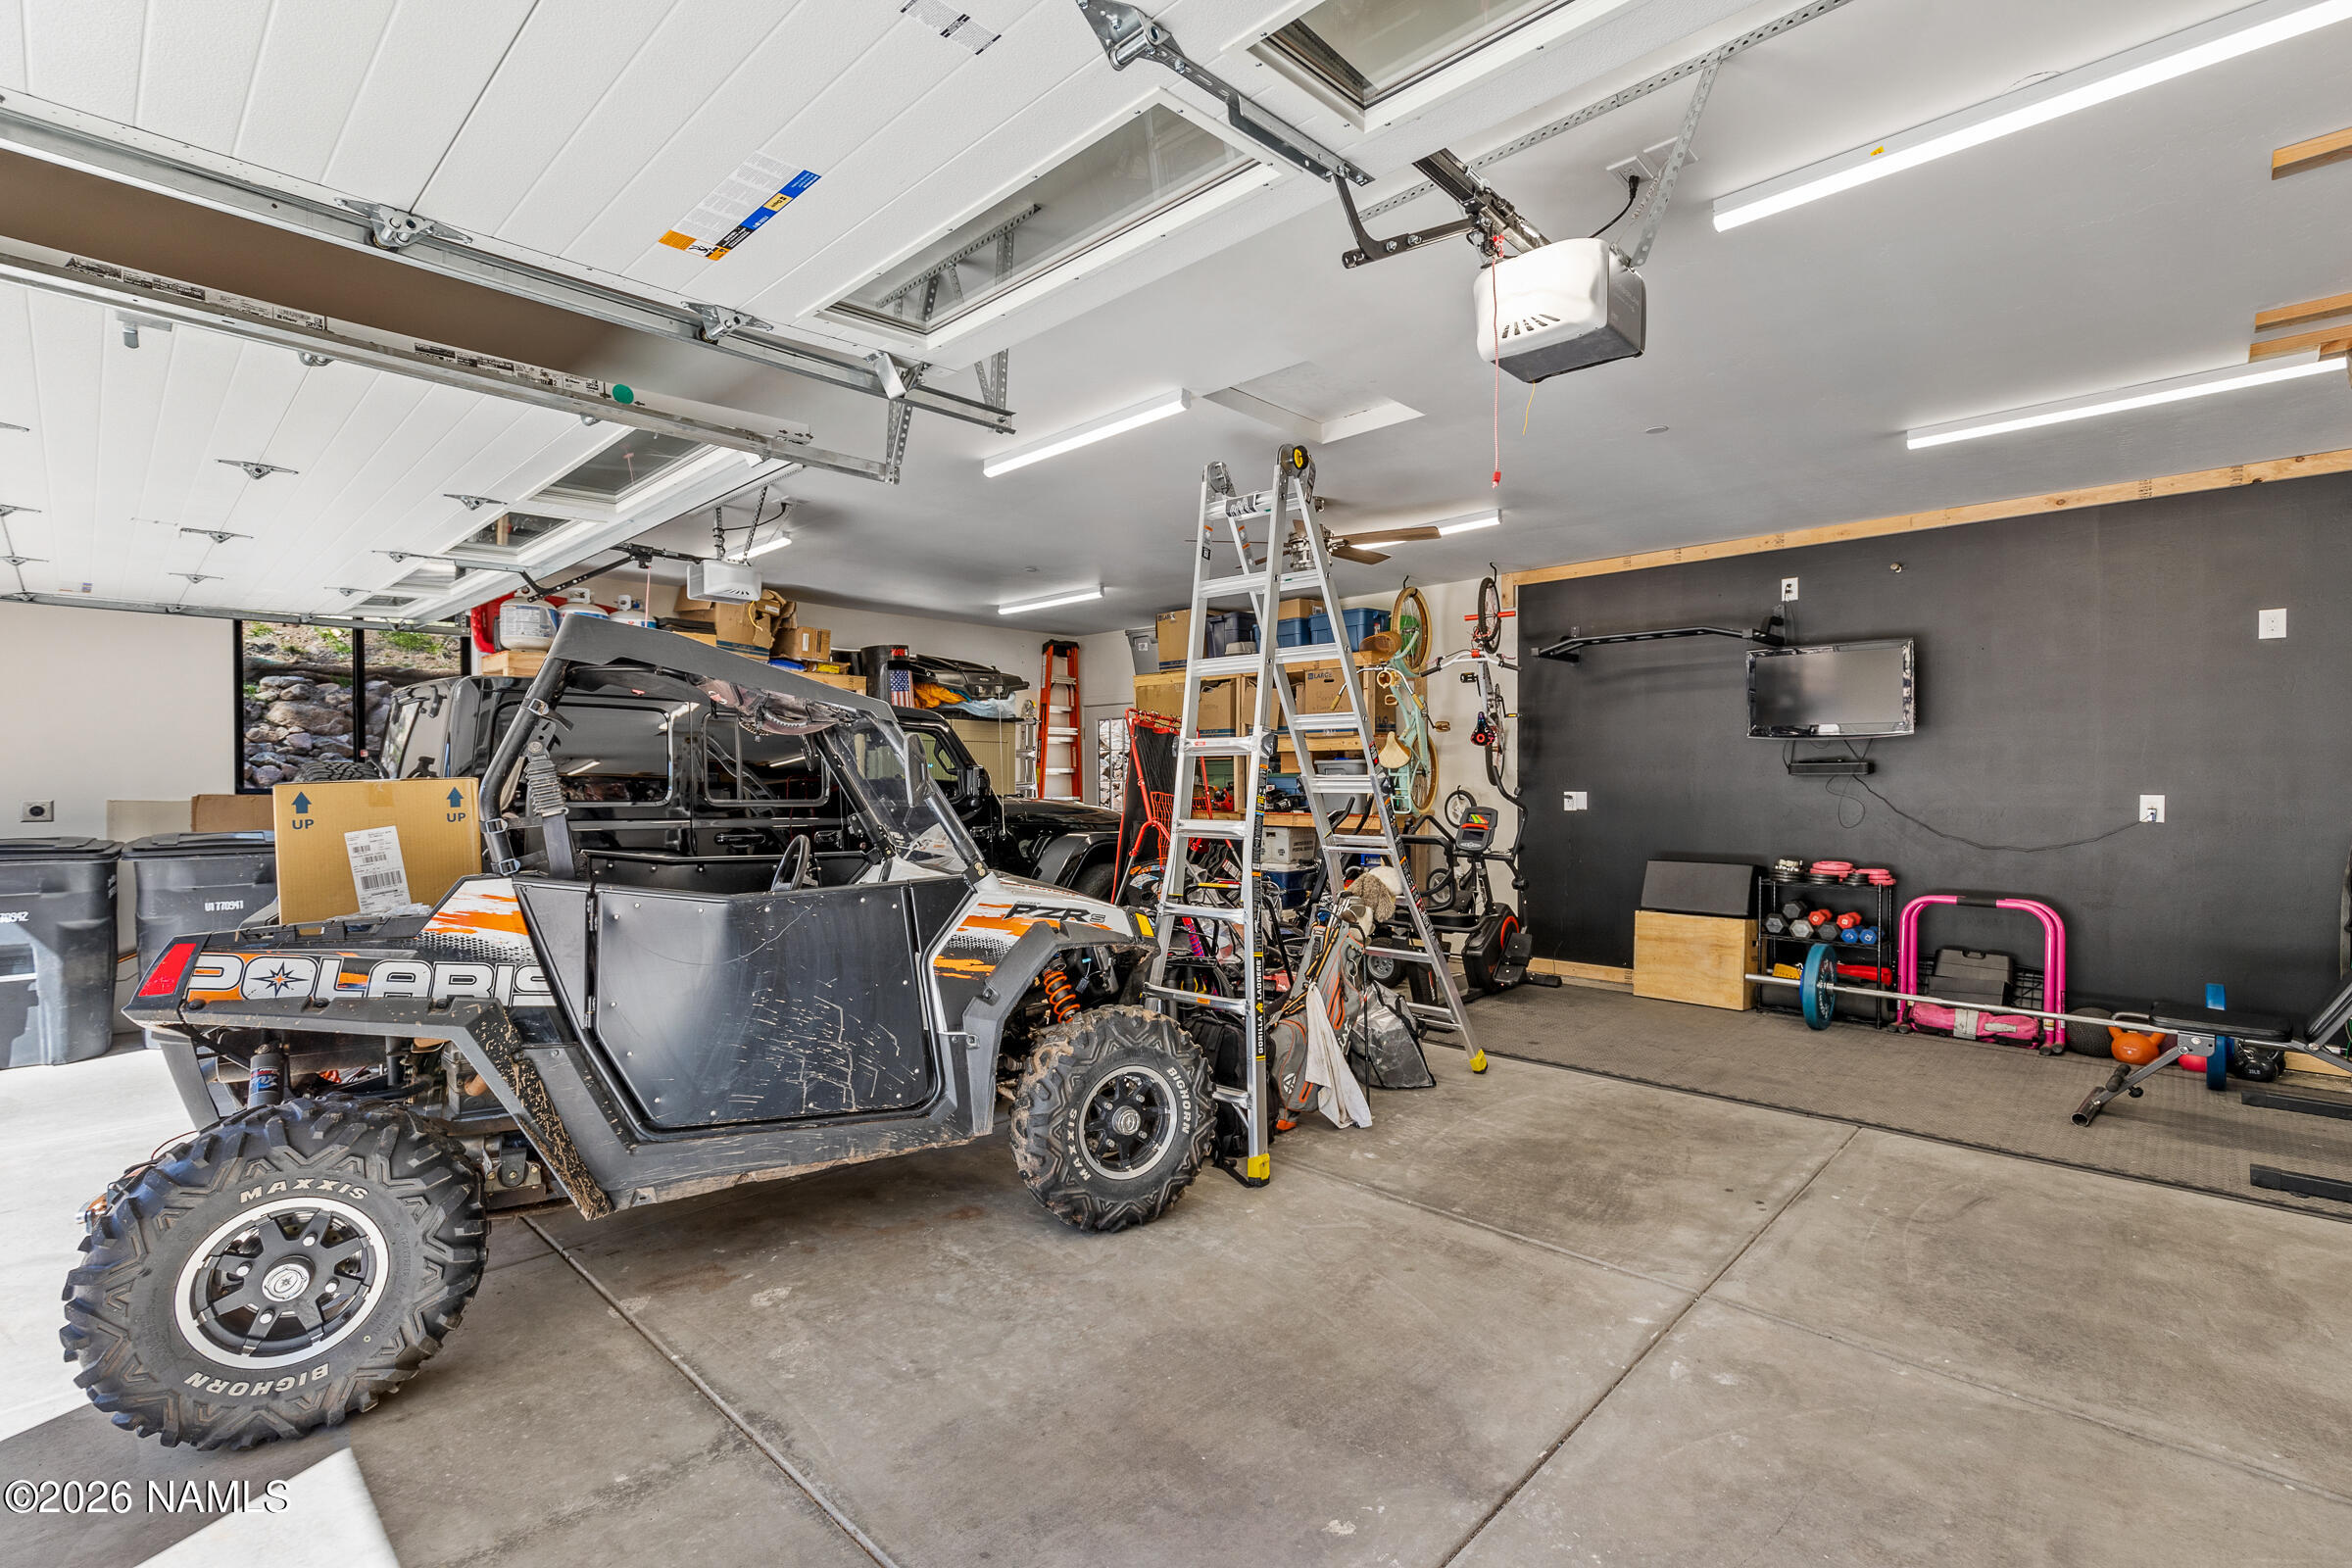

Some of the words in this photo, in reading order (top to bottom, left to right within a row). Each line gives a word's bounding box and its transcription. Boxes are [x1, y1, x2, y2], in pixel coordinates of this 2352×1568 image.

[292, 819, 315, 830] UP
[447, 812, 466, 822] UP
[186, 955, 557, 1007] POLARIS
[1167, 1066, 1193, 1135] BIGHORN
[1066, 1108, 1092, 1182] MAXXIS
[240, 1178, 369, 1204] MAXXIS
[183, 1363, 329, 1396] BIGHORN
